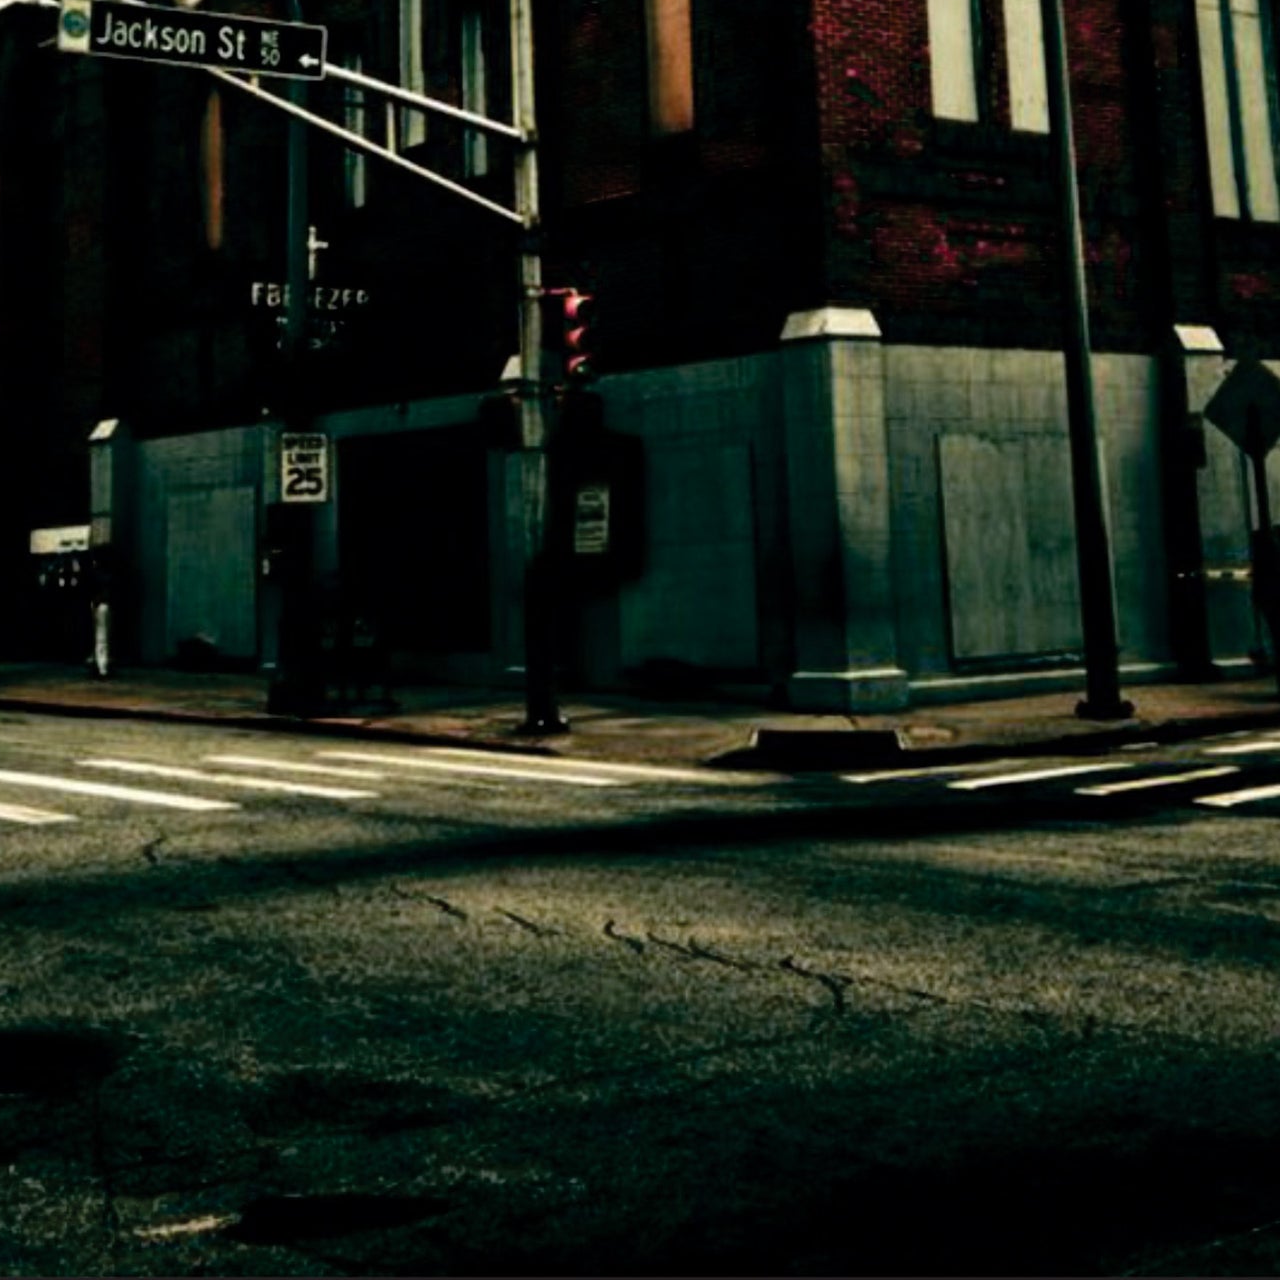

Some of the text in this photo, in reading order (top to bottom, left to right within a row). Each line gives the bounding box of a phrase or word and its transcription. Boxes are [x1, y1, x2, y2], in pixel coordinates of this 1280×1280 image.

[96, 11, 246, 61] Jackson St
[261, 30, 280, 48] NE
[286, 453, 320, 465] LIMIT
[286, 468, 323, 496] 25
